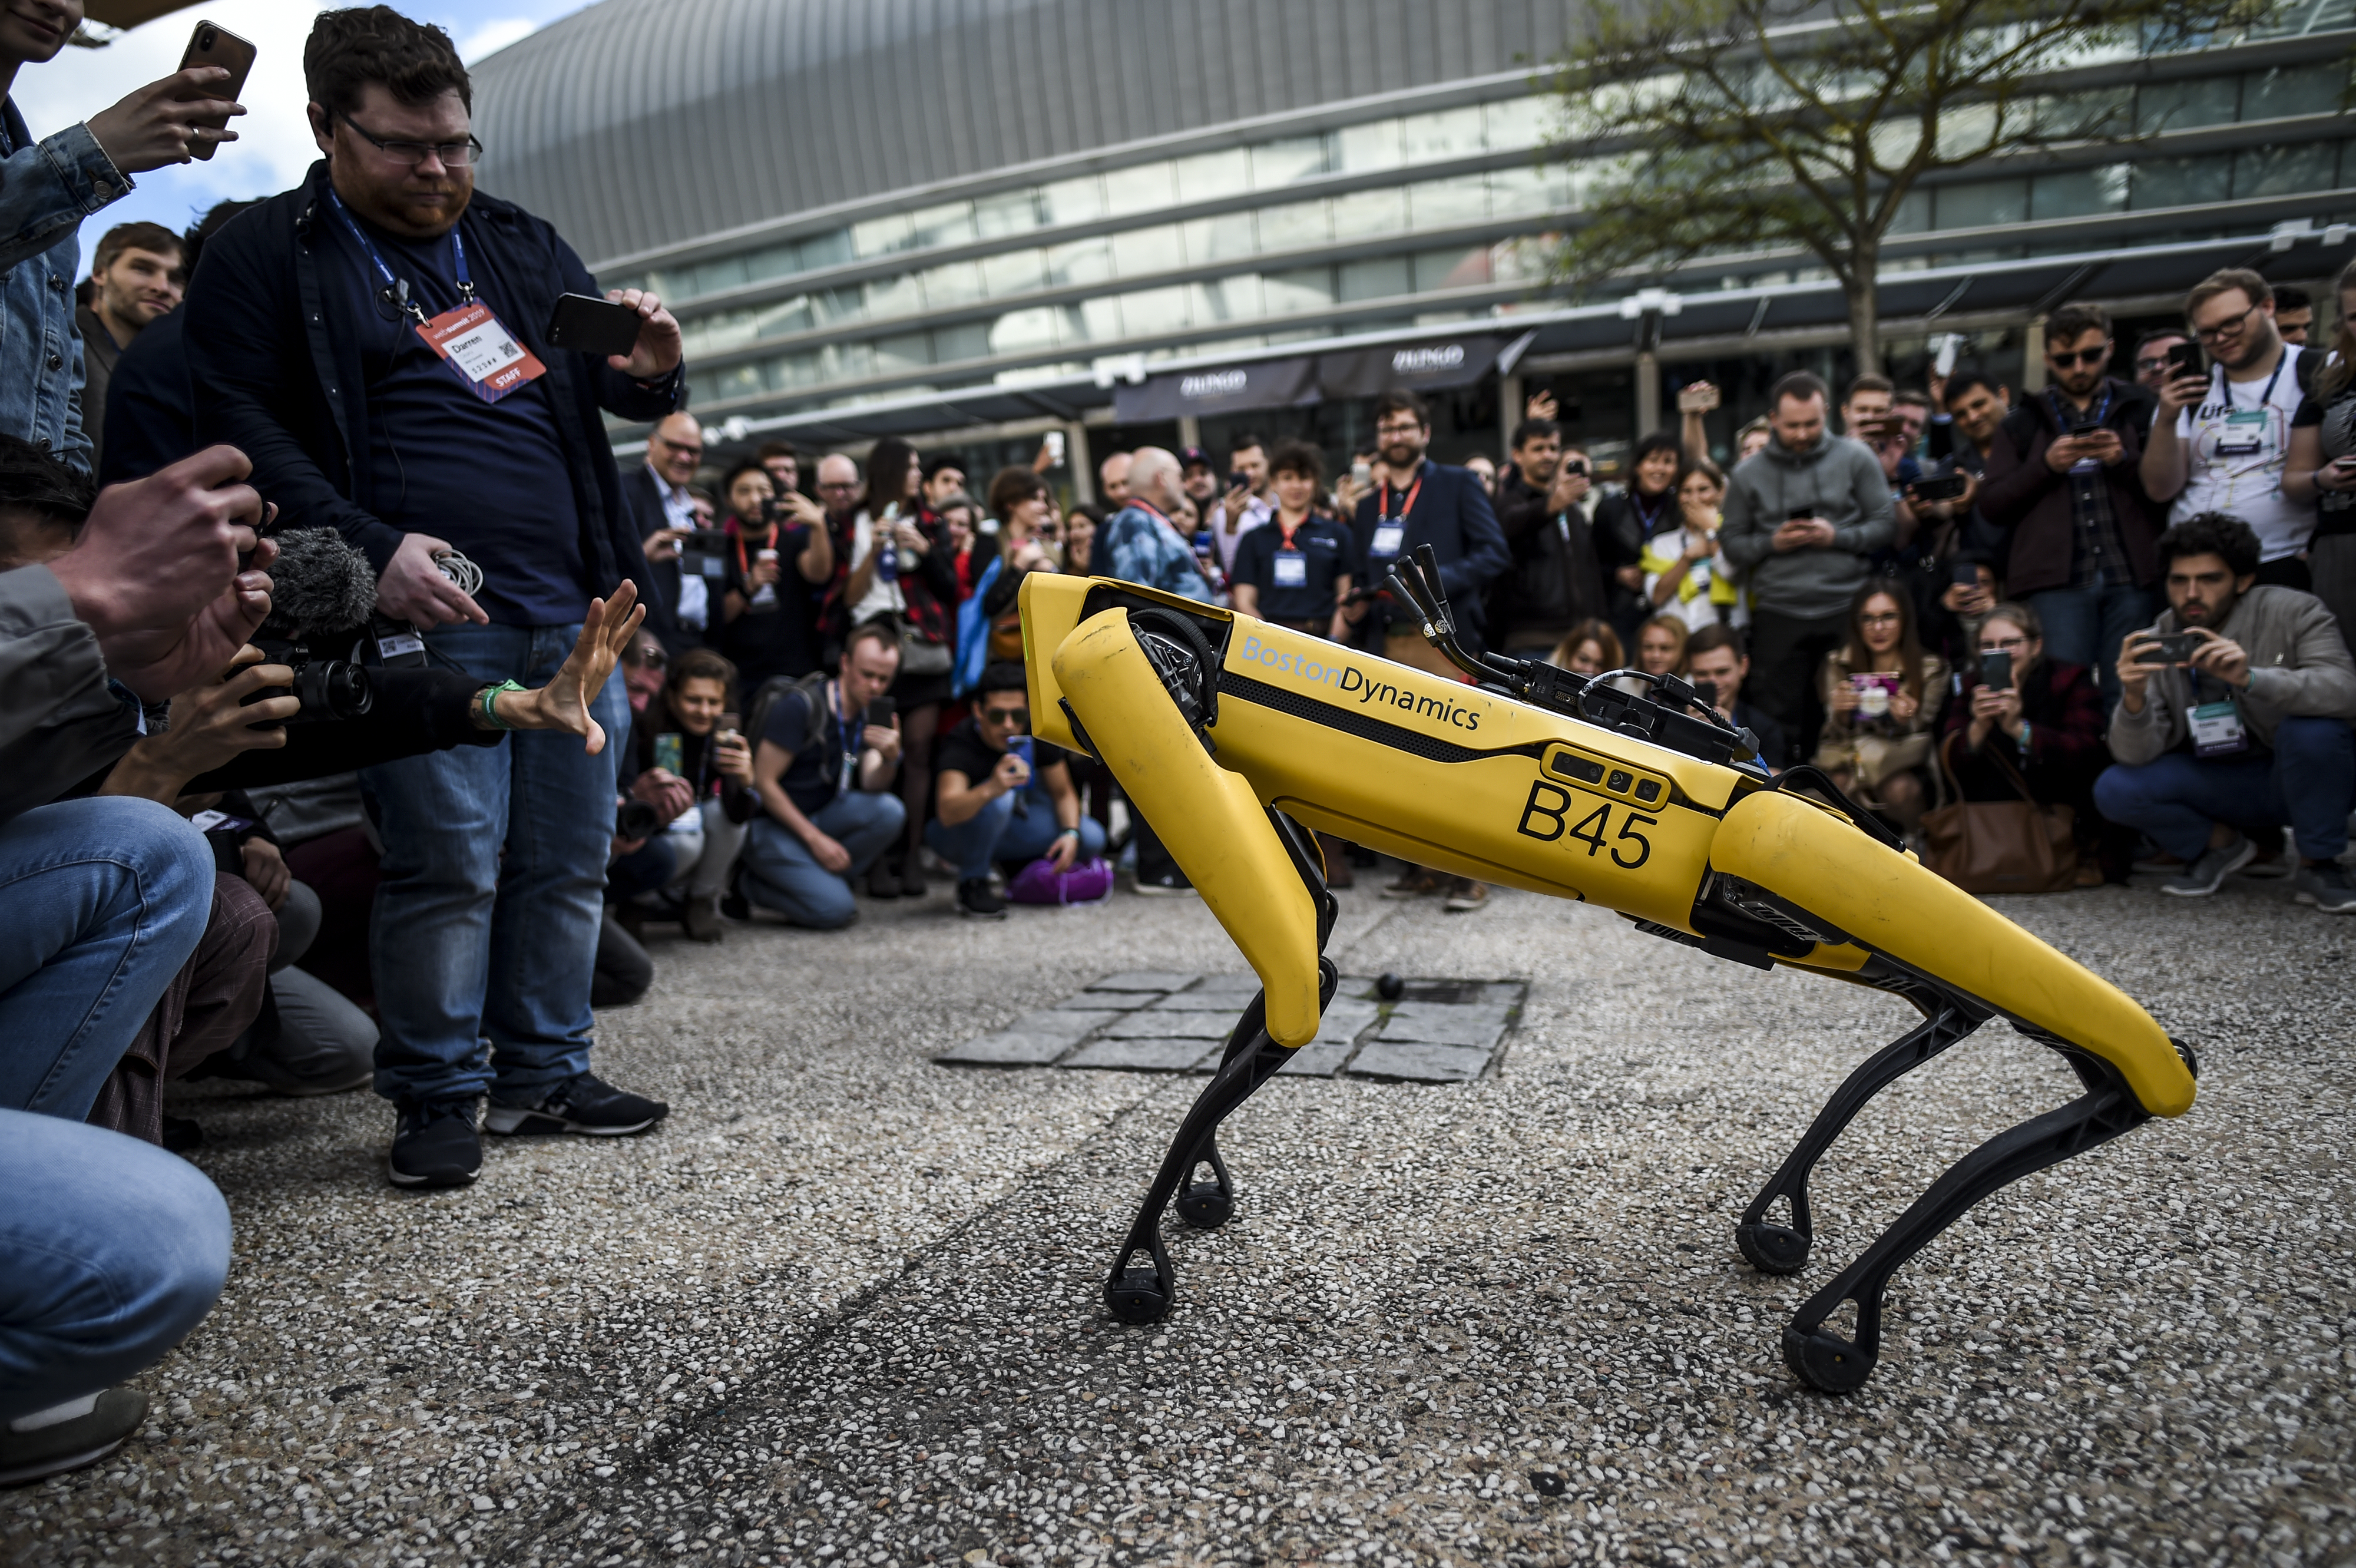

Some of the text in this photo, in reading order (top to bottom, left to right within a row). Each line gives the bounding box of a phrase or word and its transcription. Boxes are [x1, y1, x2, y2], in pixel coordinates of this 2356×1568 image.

[452, 335, 482, 353] Darren
[495, 367, 521, 387] STAFF
[1517, 779, 1659, 870] B45
